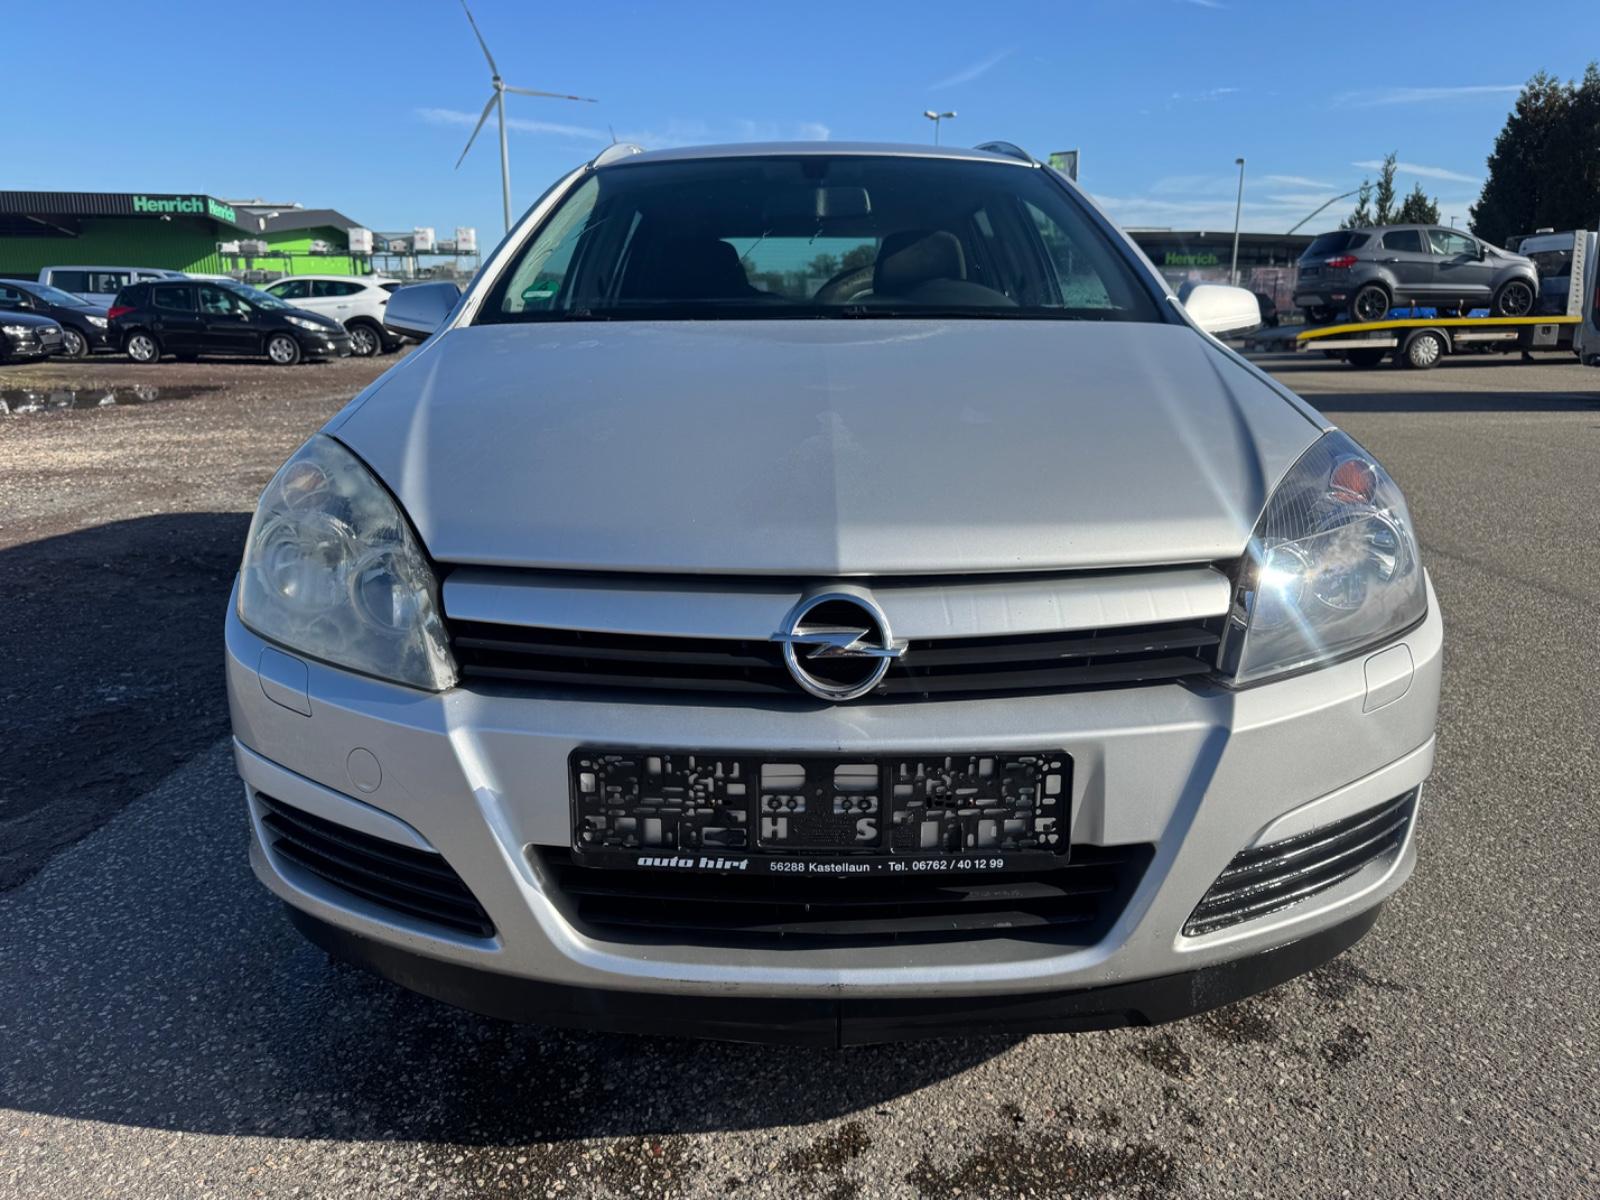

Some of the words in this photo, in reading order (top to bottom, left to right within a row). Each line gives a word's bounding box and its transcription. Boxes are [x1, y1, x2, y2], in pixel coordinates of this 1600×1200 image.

[133, 195, 204, 213] Henrich
[1165, 251, 1217, 265] Henrich
[637, 856, 695, 868] auto
[698, 857, 749, 870] hirt
[770, 861, 806, 872] 56288
[808, 862, 871, 873] Kastellaun
[888, 861, 909, 871] Tel.
[911, 860, 948, 871] 06762
[957, 859, 972, 869] 40
[989, 858, 1004, 868] 99
